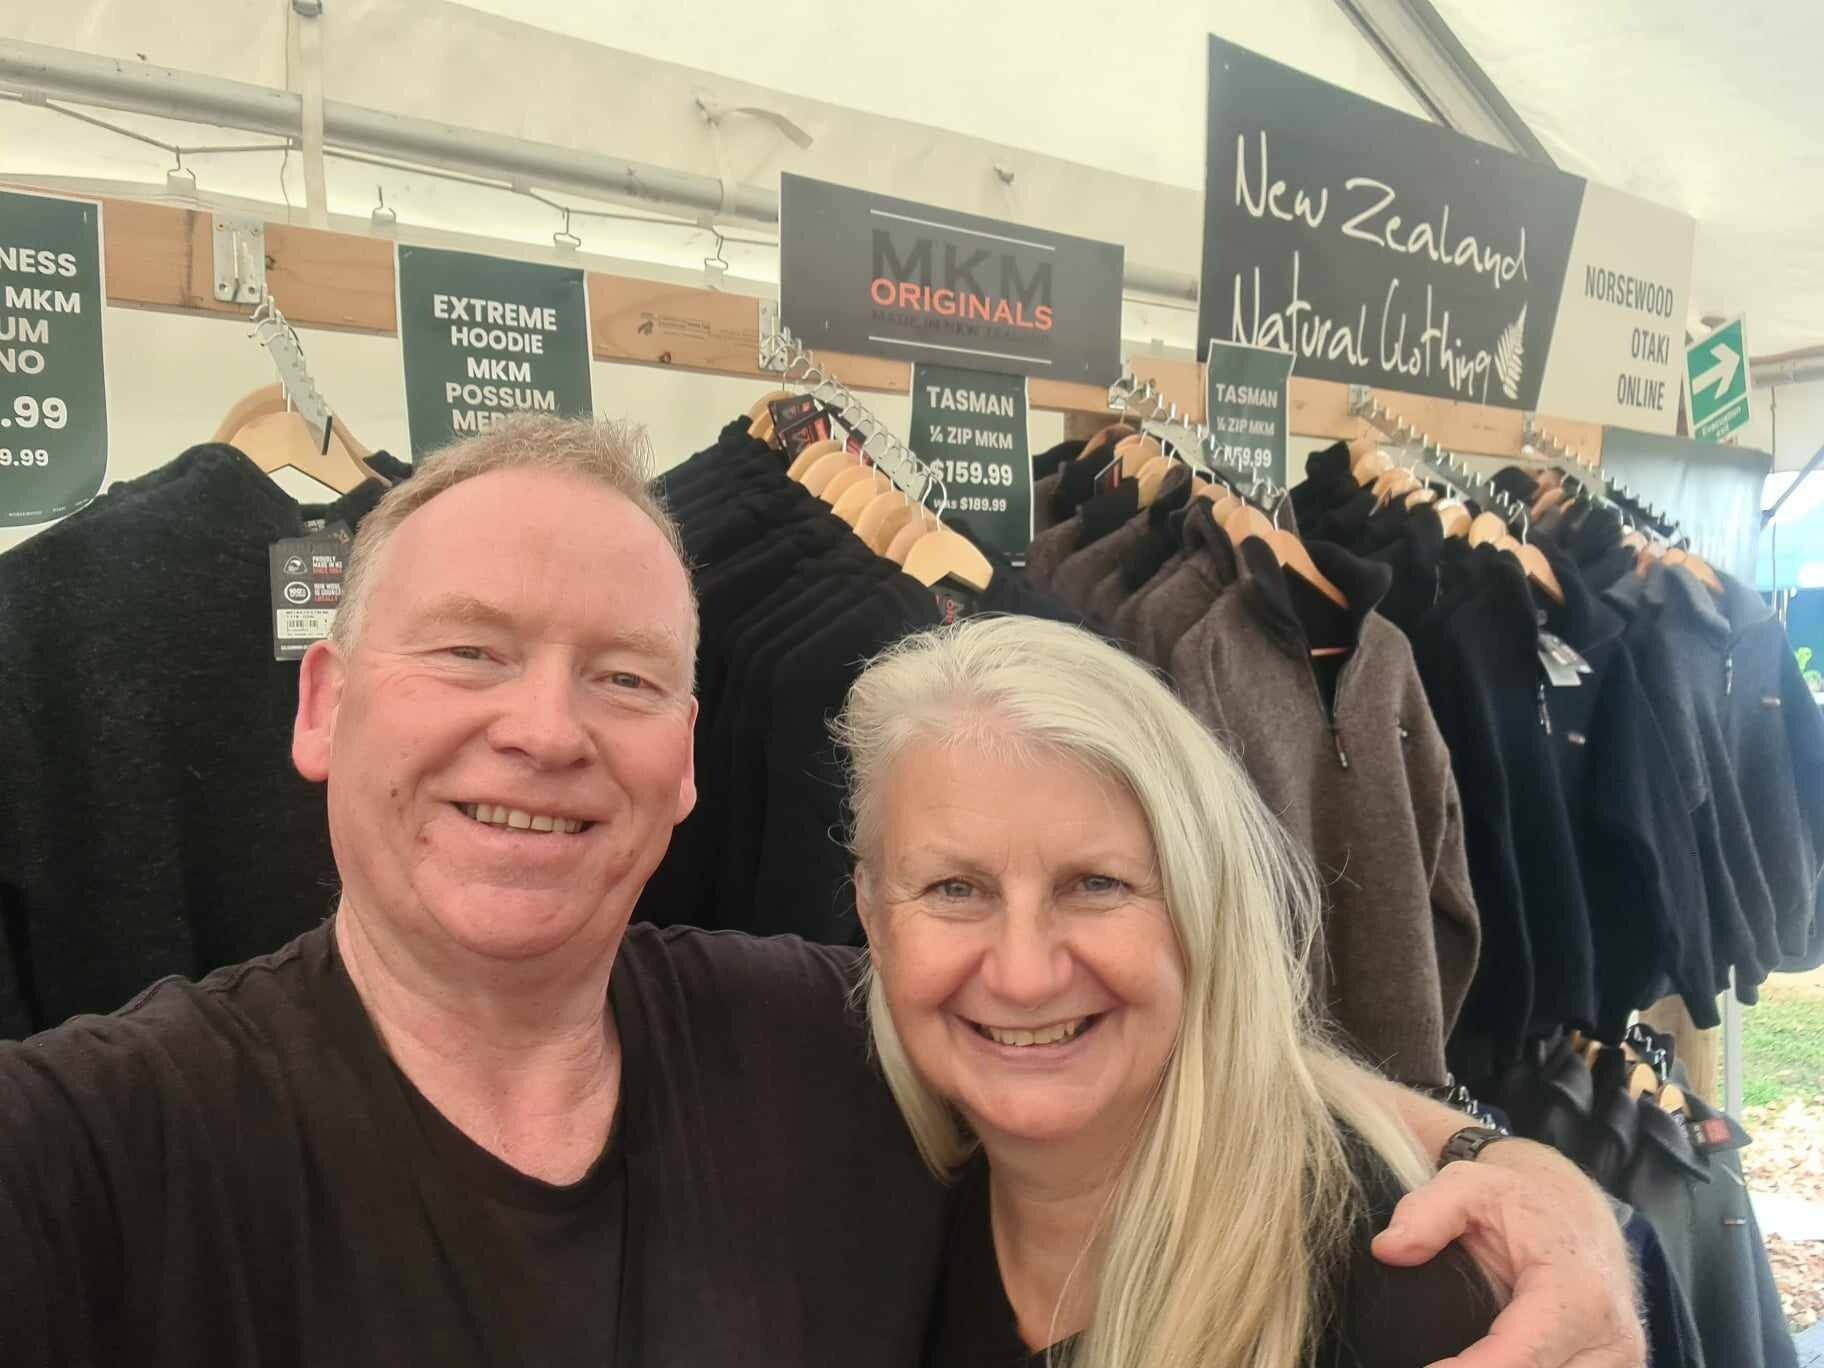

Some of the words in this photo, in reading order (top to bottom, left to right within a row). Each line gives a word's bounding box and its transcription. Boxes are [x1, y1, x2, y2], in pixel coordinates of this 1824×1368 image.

[1236, 130, 1328, 228] New
[1341, 177, 1528, 289] Zealand
[871, 228, 1054, 308] MKM
[5, 286, 81, 314] MKM
[870, 277, 1054, 331] ORIGINALS
[1584, 264, 1674, 318] NORSEWOOD
[433, 293, 557, 332] EXTREME
[1232, 250, 1369, 367] Natural
[1380, 277, 1492, 405] Clothing
[450, 325, 544, 354] HOODIE
[1630, 327, 1670, 366] OTAKI
[467, 356, 531, 383] MKM
[445, 382, 555, 411] POSSUM
[926, 385, 1014, 418] TASMAN
[1215, 383, 1278, 409] TASMAN
[1617, 373, 1665, 411] ONLINE
[947, 426, 972, 446] ZIP
[974, 429, 1014, 450] MKM
[1227, 417, 1248, 433] ZIP
[1248, 420, 1275, 437] MKM
[929, 458, 1013, 487] $159.99
[959, 496, 1007, 513] $189.99
